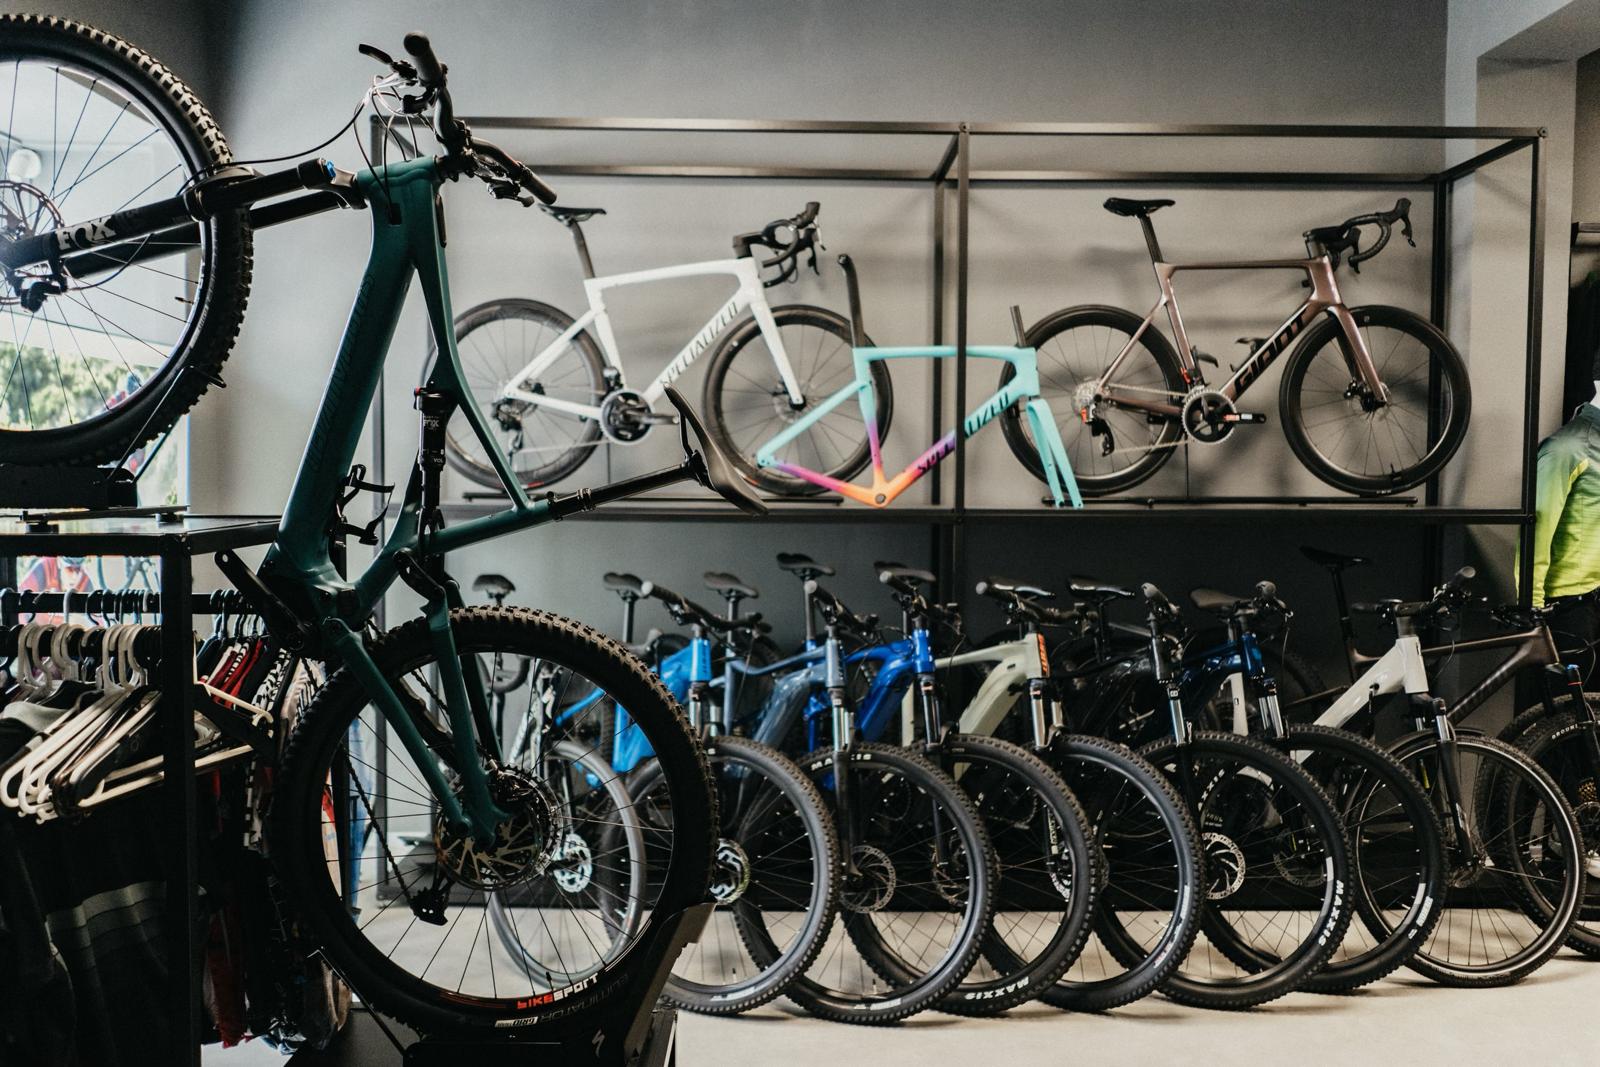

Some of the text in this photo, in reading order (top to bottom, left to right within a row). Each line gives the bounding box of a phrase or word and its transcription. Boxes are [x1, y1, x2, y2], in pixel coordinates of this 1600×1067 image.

[56, 215, 117, 251] FOX
[1234, 306, 1307, 399] GIANT
[811, 753, 872, 771] MAIS
[1318, 879, 1345, 947] MAXXIS
[963, 976, 1029, 1001] MAXXIS
